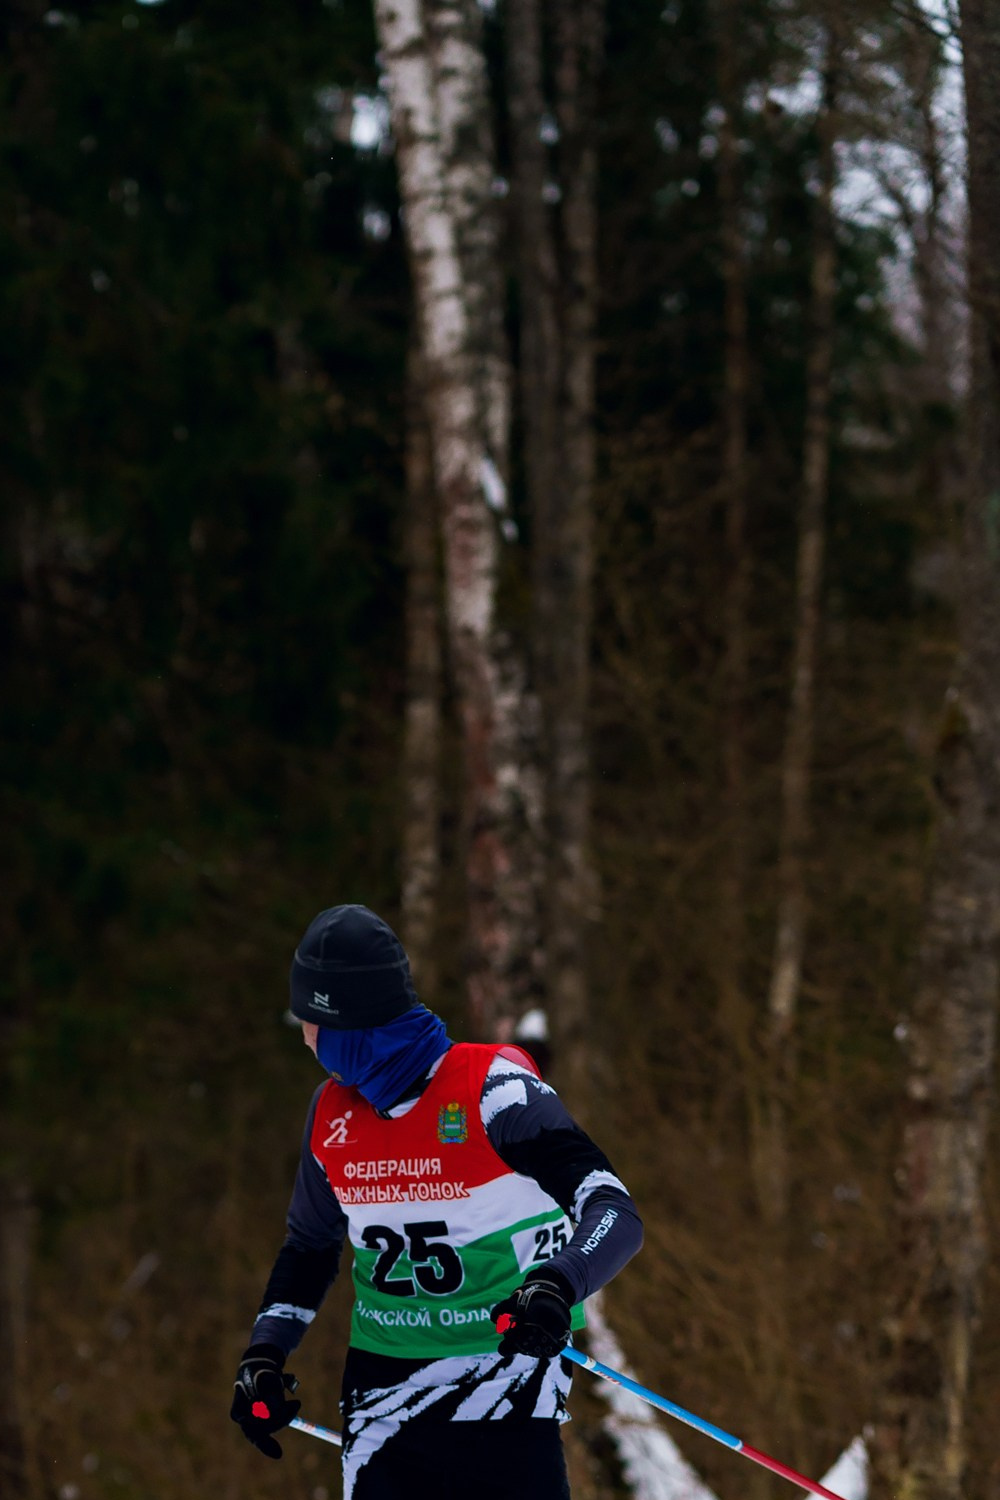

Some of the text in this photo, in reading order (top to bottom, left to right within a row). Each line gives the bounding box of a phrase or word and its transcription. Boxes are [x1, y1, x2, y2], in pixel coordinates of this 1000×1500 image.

[343, 1158, 442, 1182] ФЕДЕРАЦИЯ
[408, 1182, 470, 1201] ГОНОК
[533, 1222, 567, 1262] 25
[580, 1208, 619, 1255] NORDSKI
[361, 1220, 465, 1297] 25
[439, 1304, 496, 1326] ОБЛА
